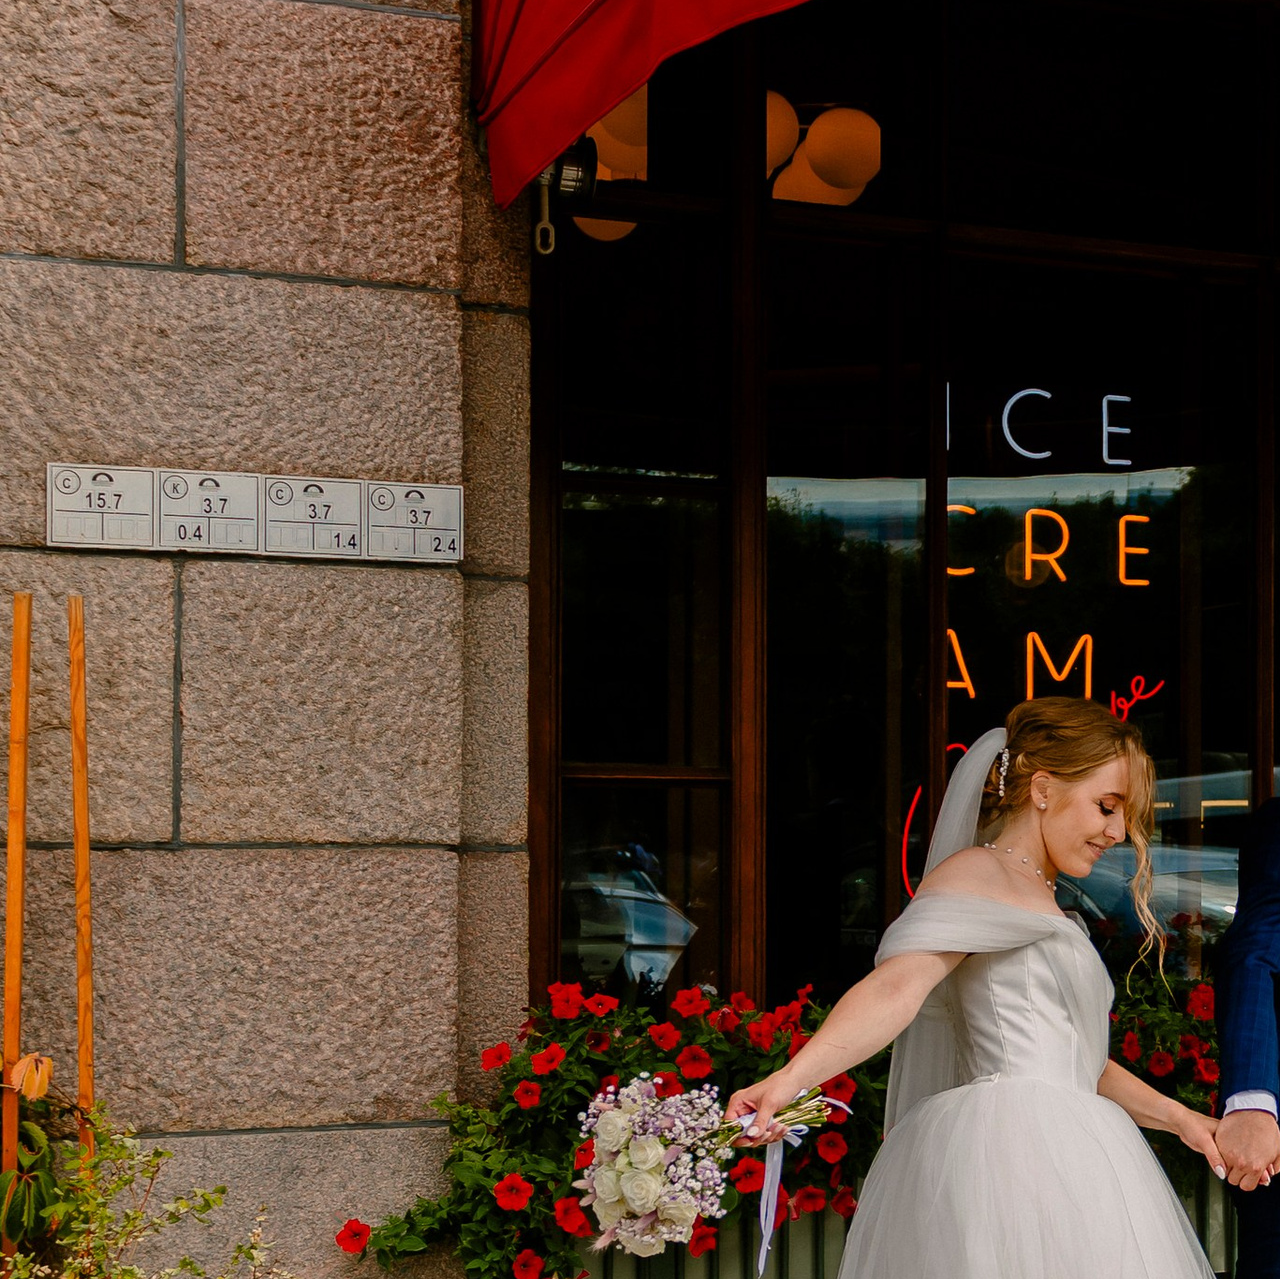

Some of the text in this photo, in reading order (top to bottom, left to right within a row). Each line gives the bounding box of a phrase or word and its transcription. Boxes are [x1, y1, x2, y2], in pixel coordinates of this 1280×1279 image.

[945, 382, 1132, 465] ICE
[85, 492, 123, 510] 15.7
[203, 497, 228, 514] 3.7
[308, 503, 332, 520] 3.7
[409, 509, 431, 526] 3.7
[178, 524, 203, 541] 0.4
[333, 532, 357, 550] 1.4
[433, 536, 457, 554] 2.4
[945, 504, 1151, 586] CRE
[945, 628, 1093, 701] AM
